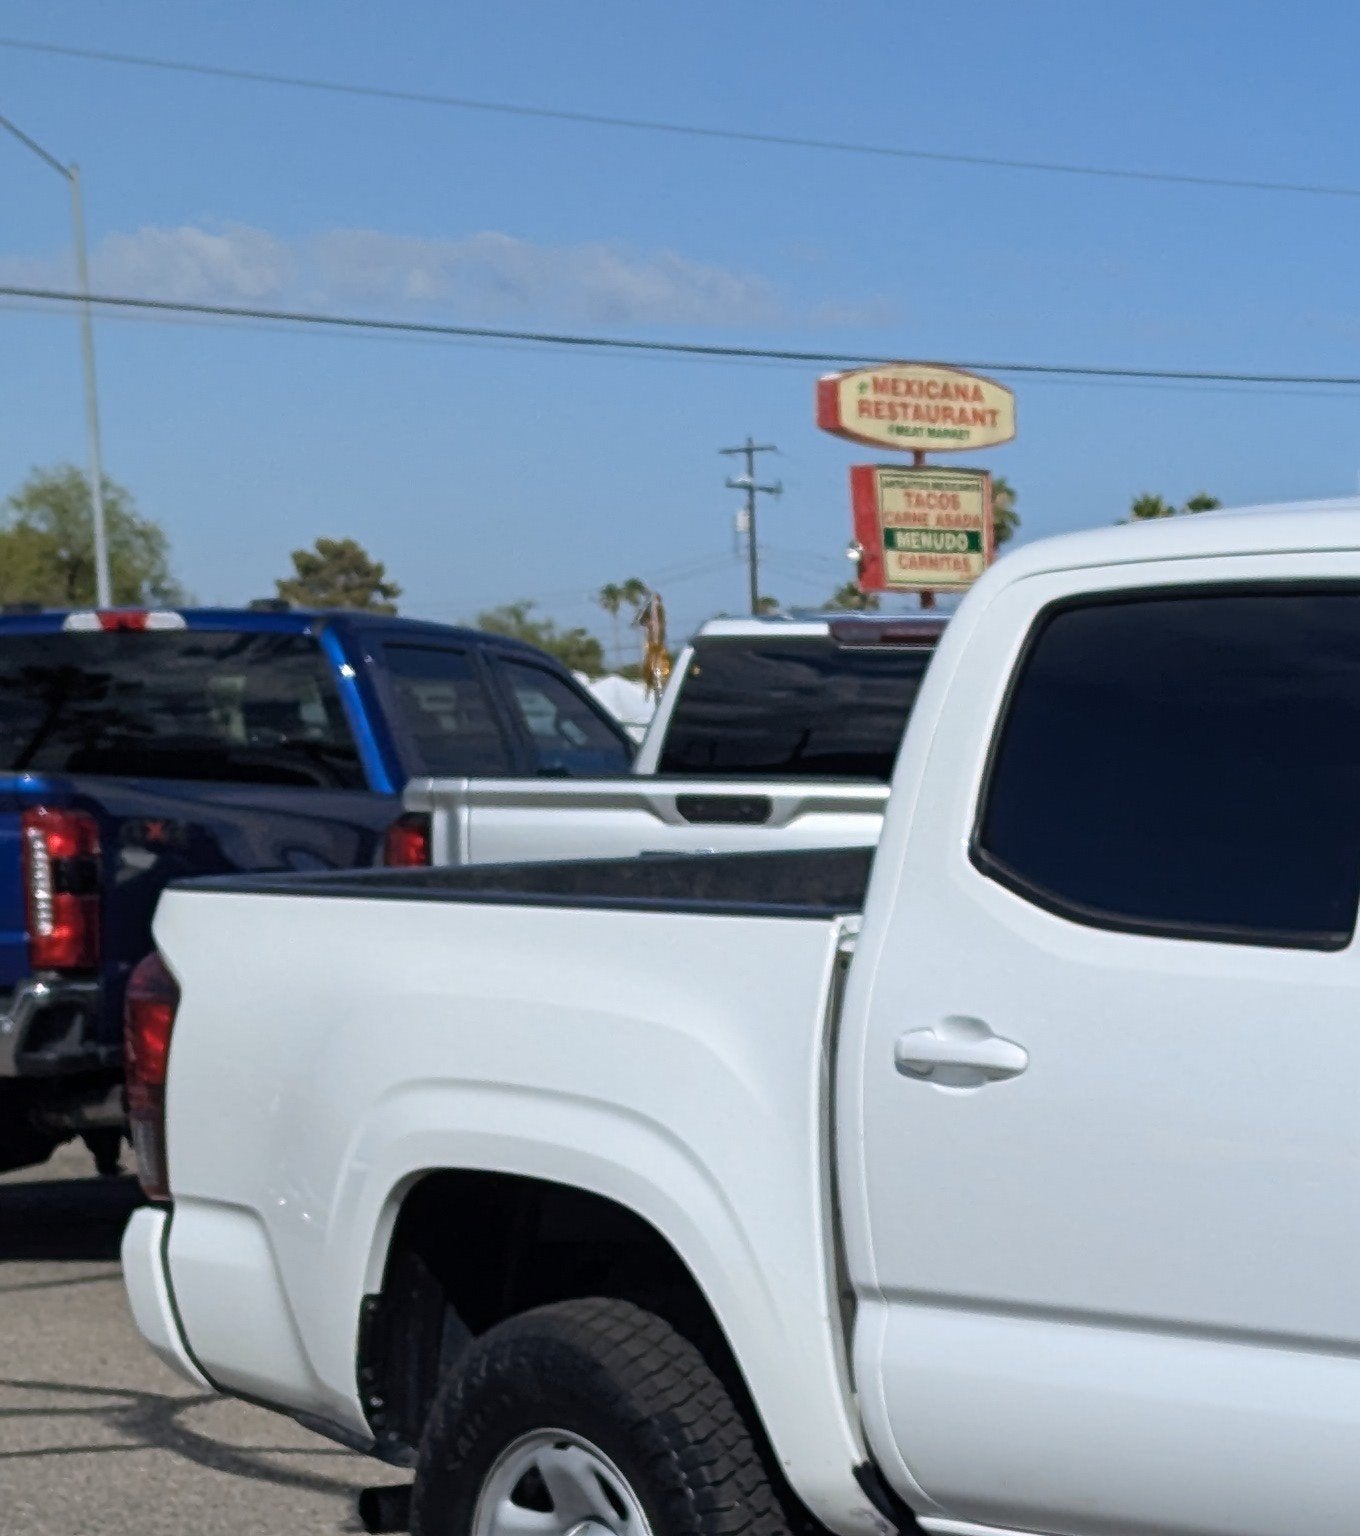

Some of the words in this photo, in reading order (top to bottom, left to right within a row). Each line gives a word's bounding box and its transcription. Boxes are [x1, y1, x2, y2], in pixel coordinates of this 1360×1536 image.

[872, 376, 986, 403] MEXICANA
[857, 399, 1000, 428] RESTAURANT
[903, 490, 961, 512] TACOS
[895, 530, 969, 553] MENUDO
